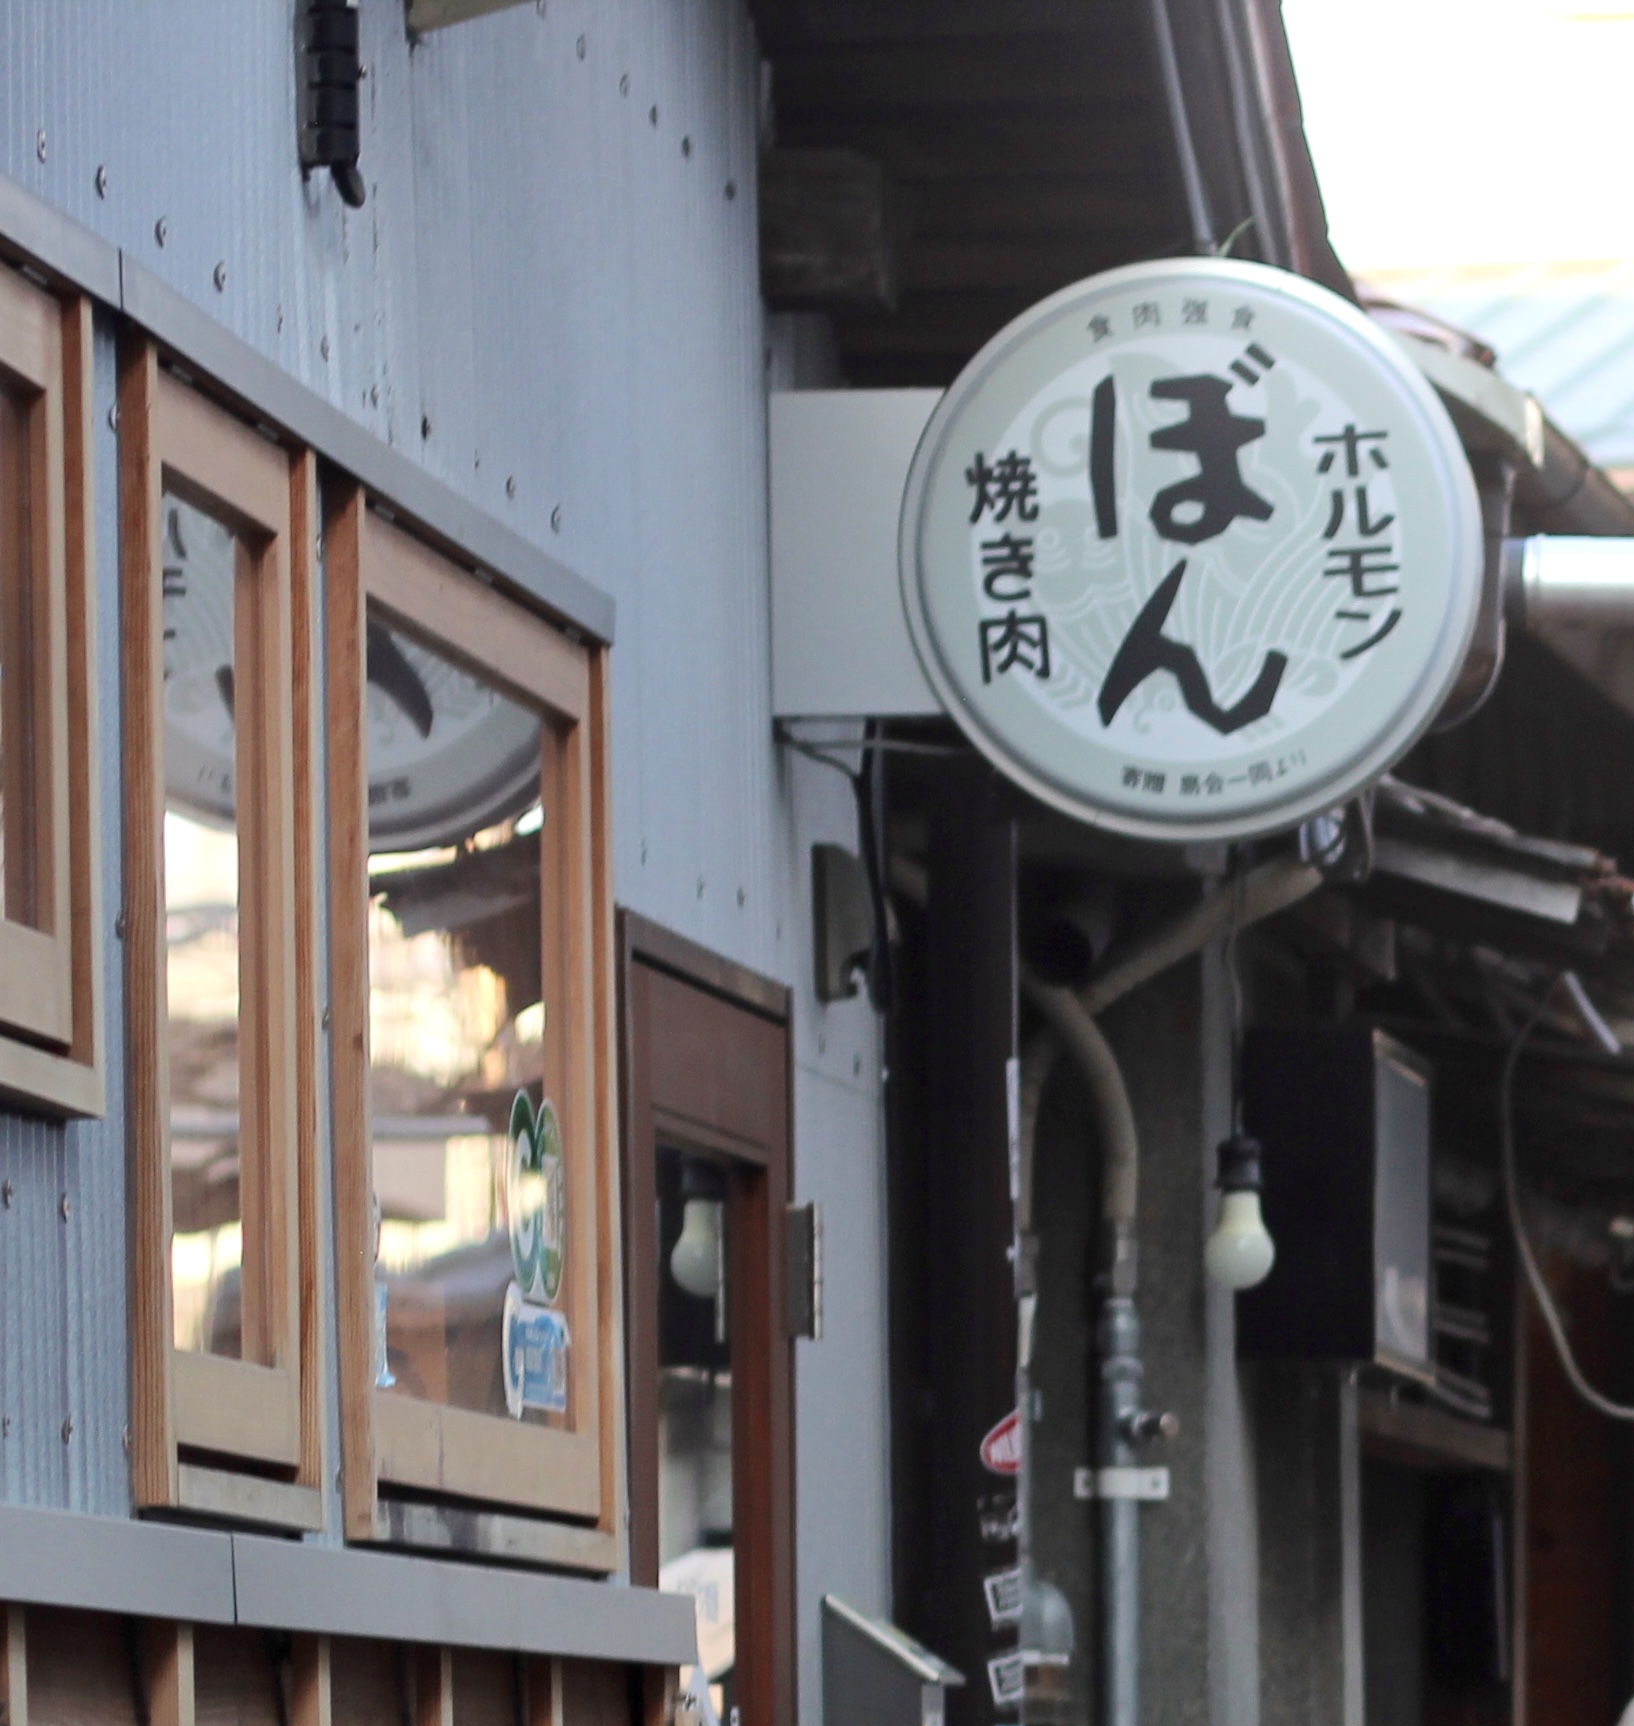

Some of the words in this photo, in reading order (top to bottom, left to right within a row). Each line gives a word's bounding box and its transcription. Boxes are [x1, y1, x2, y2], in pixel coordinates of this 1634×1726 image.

[964, 450, 1051, 685] 焼き肉
[1090, 343, 1287, 735] ぼん
[1313, 423, 1403, 661] ホルモン
